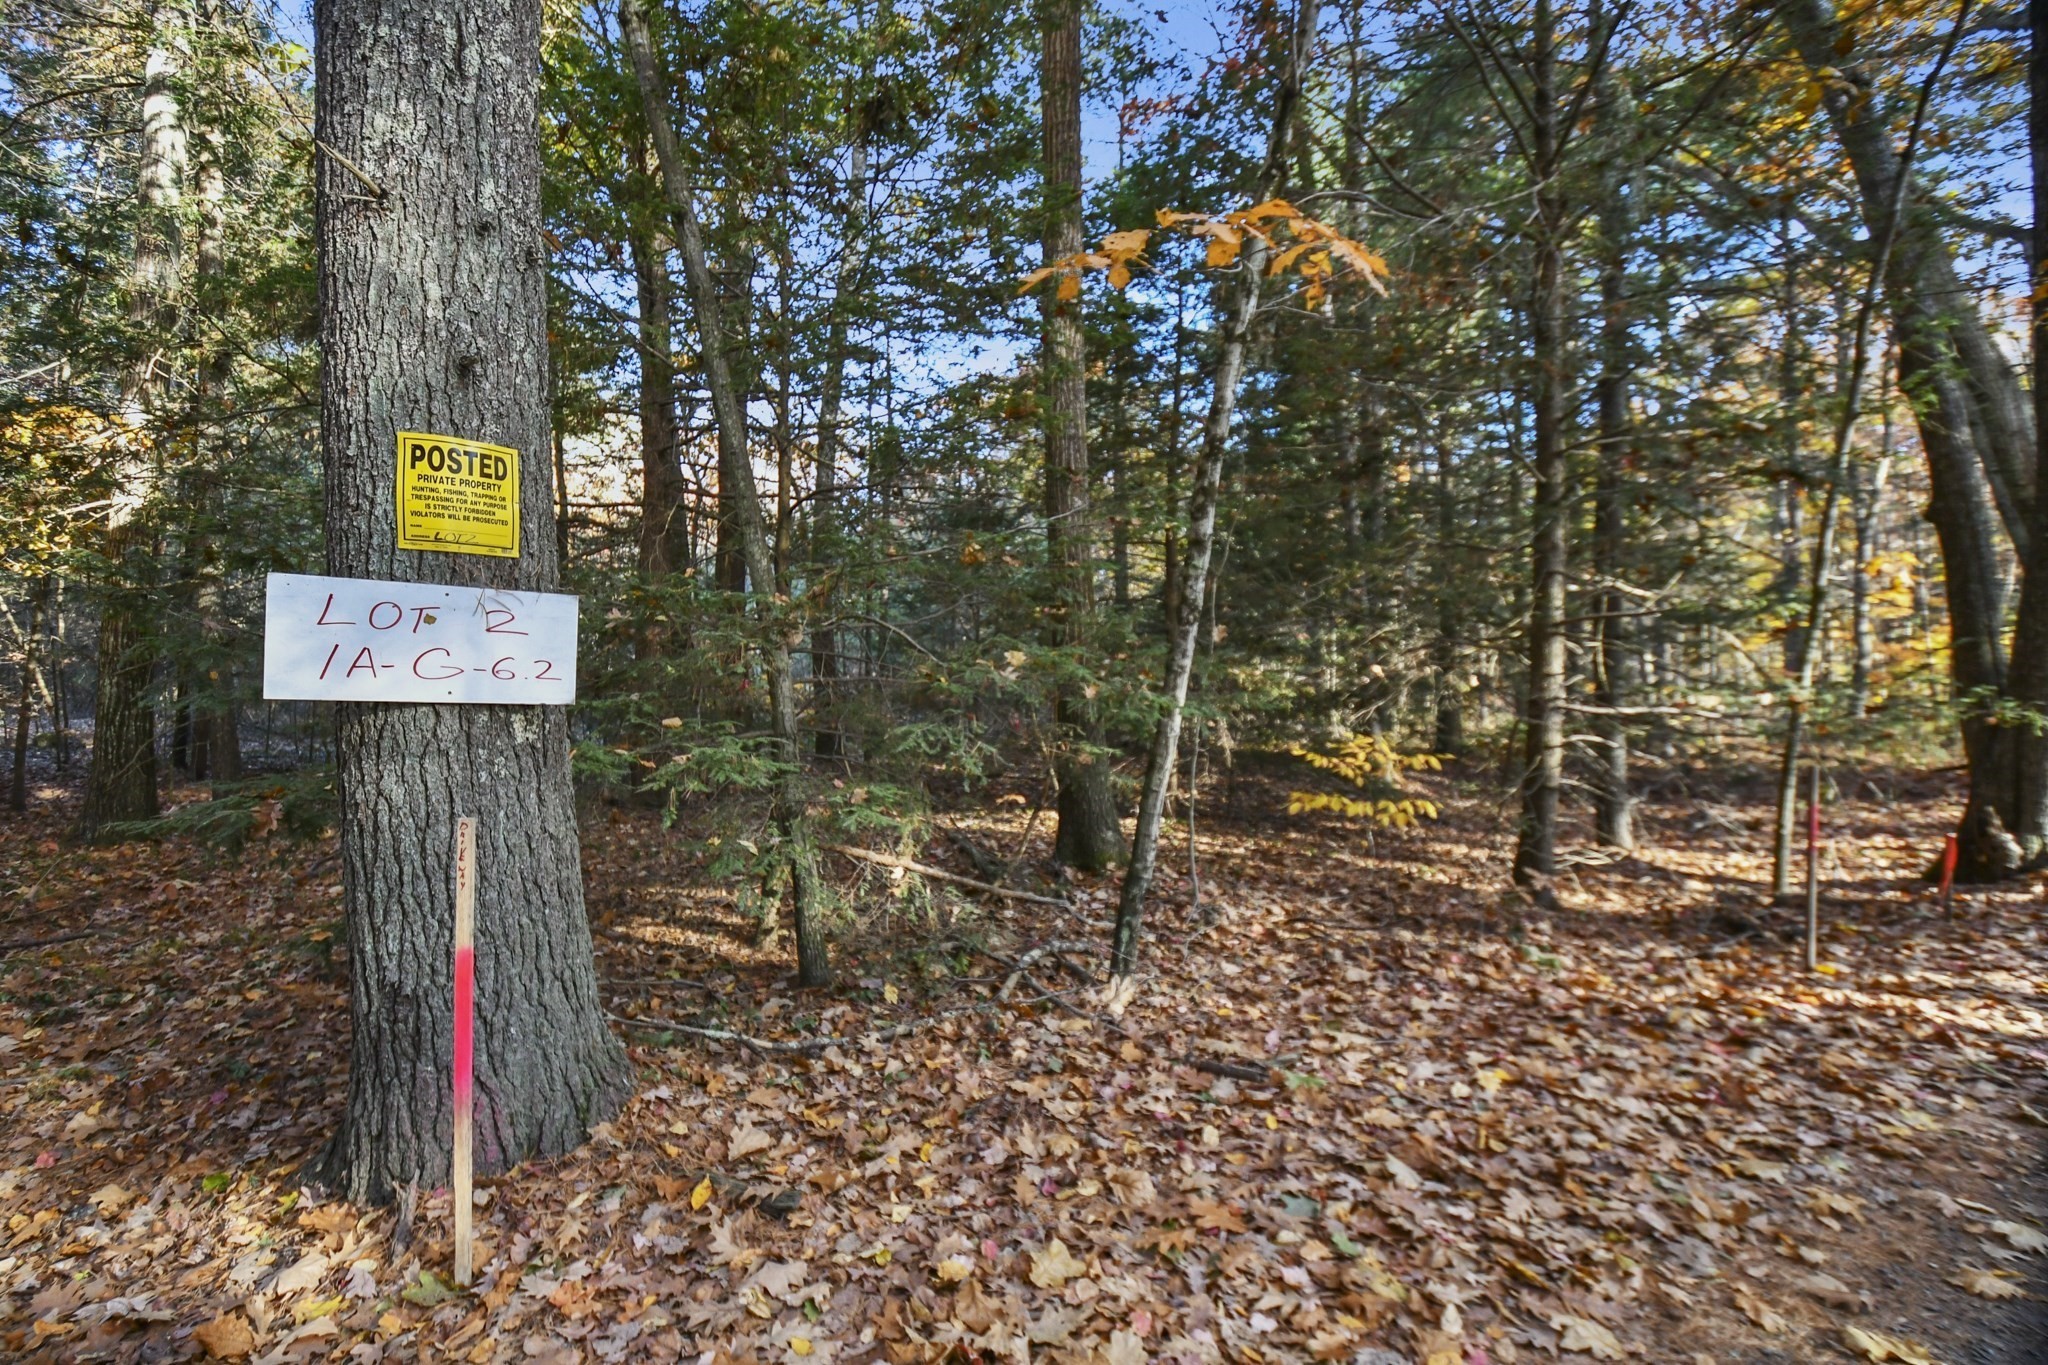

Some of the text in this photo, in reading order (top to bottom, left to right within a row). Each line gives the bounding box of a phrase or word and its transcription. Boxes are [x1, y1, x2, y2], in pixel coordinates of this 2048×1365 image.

[410, 444, 508, 481] POSTED
[417, 474, 502, 492] PRIVATE PROPERTY
[412, 486, 442, 495] HUNTING,
[443, 489, 469, 498] FISHING,
[471, 492, 497, 501] TRAPPING
[411, 494, 454, 504] TRESPASSING
[483, 501, 507, 510] PURPOSE
[433, 504, 462, 512] STRICTLY
[464, 507, 496, 516] FORBIDDEN
[410, 510, 445, 519] VIOLATORS
[473, 516, 508, 526] PROSECUTED
[316, 592, 529, 636] LOT 2
